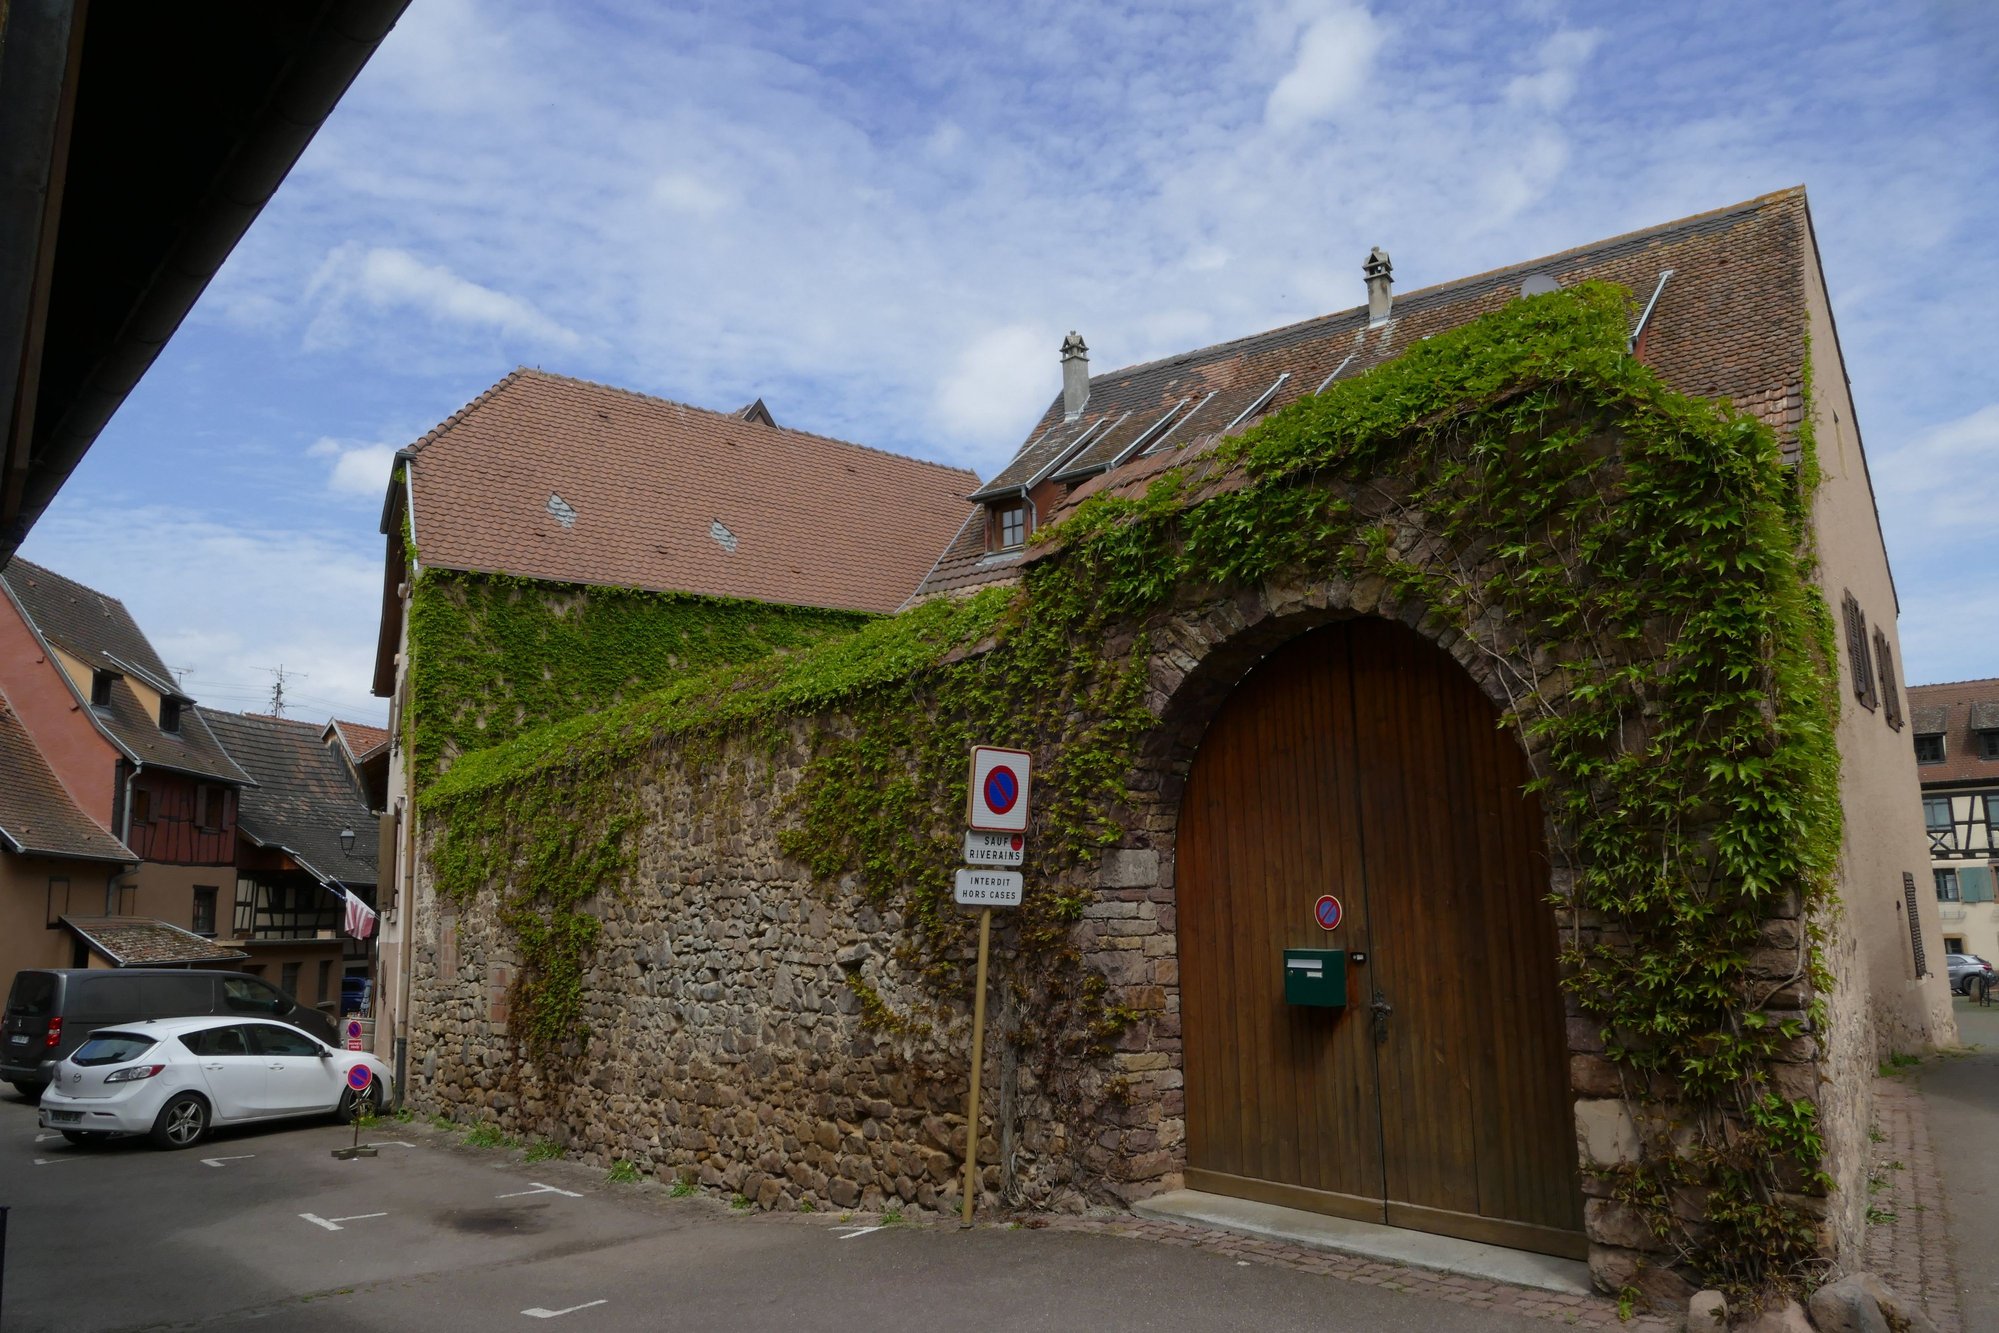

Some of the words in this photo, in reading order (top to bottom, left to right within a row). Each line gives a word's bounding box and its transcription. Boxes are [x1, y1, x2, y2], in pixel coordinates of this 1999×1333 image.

[984, 836, 1009, 846] SAUF
[969, 849, 1020, 860] RIVERAINS
[970, 877, 1011, 886] INTERDIT
[962, 890, 986, 898] HORS
[990, 891, 1016, 900] CASES
